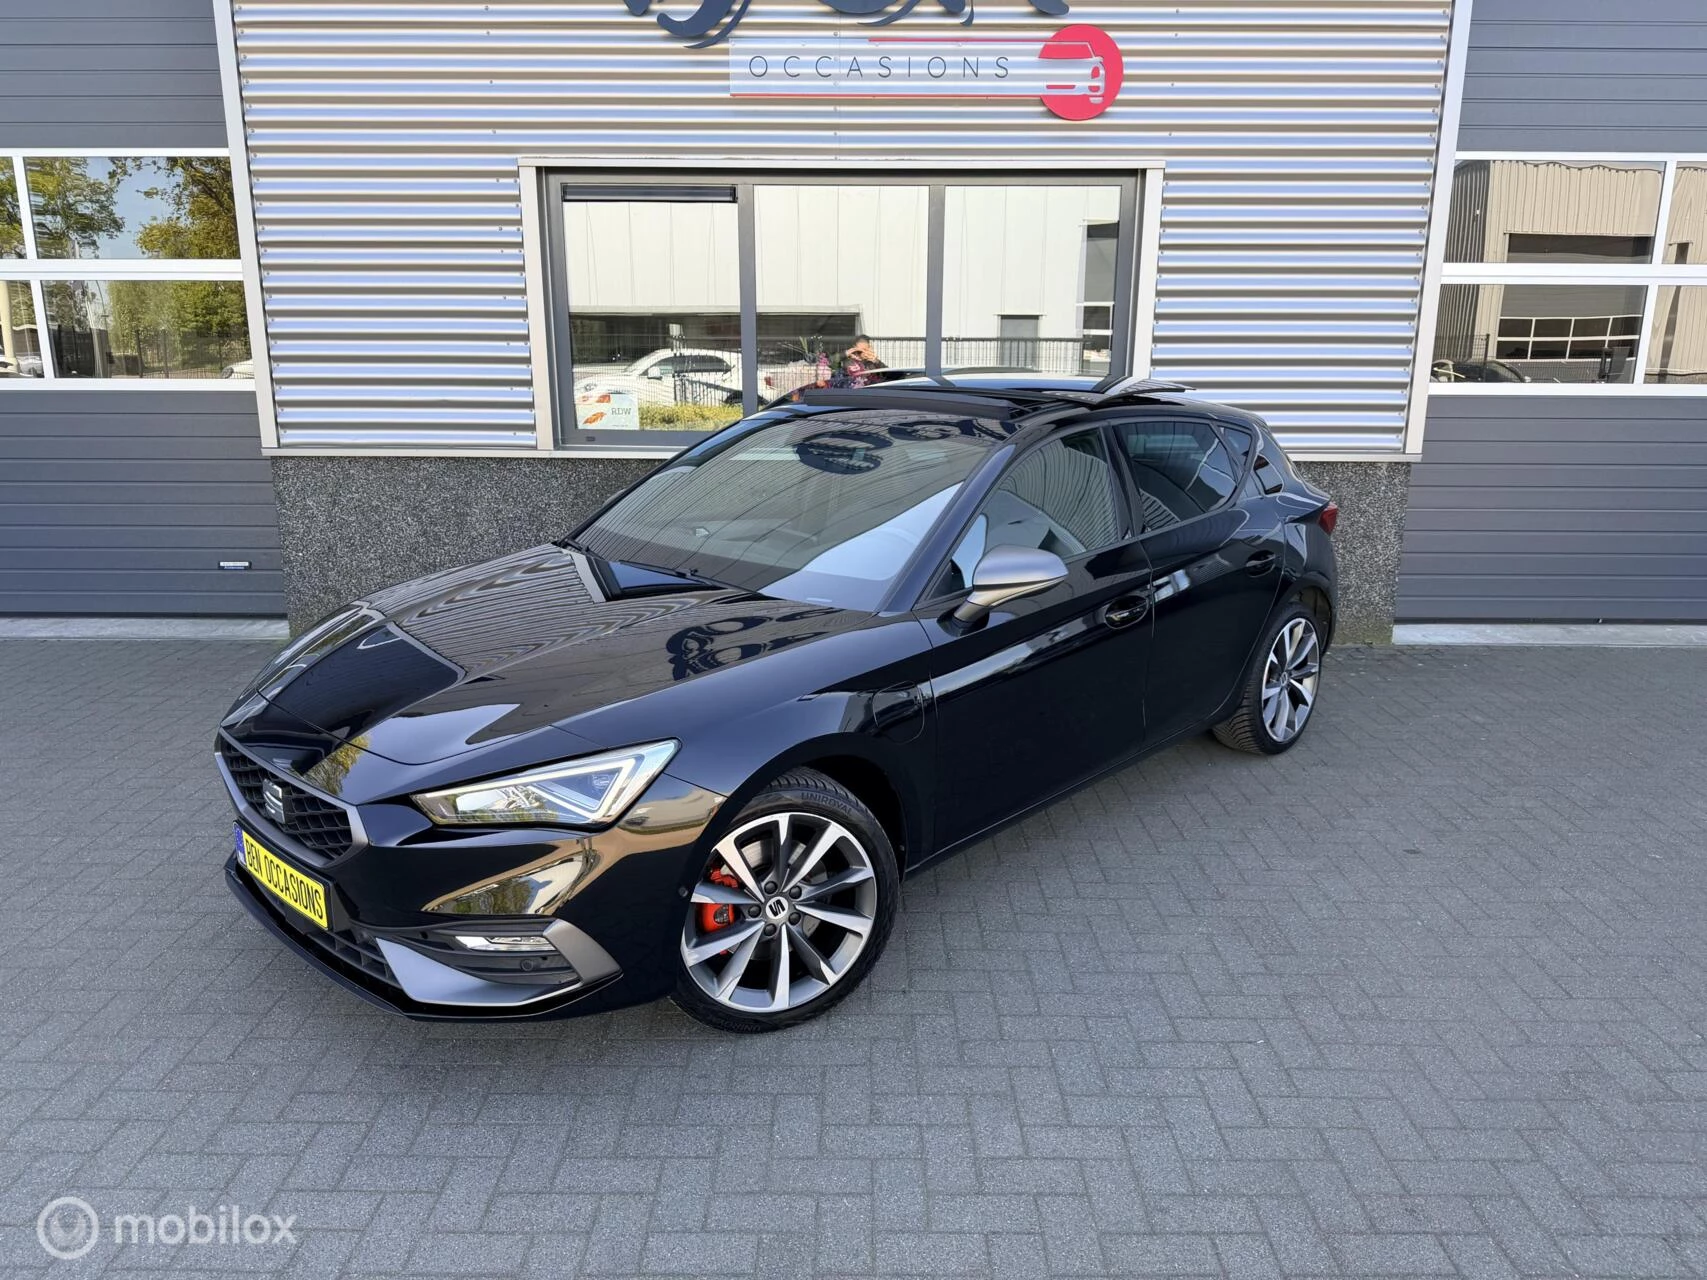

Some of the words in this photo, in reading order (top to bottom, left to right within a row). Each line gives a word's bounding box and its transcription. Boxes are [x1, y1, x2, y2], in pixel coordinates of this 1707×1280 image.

[748, 55, 1010, 79] OCCASIONS
[611, 407, 632, 415] RDW
[245, 838, 263, 877] BEN
[264, 855, 324, 920] OCCASIONS
